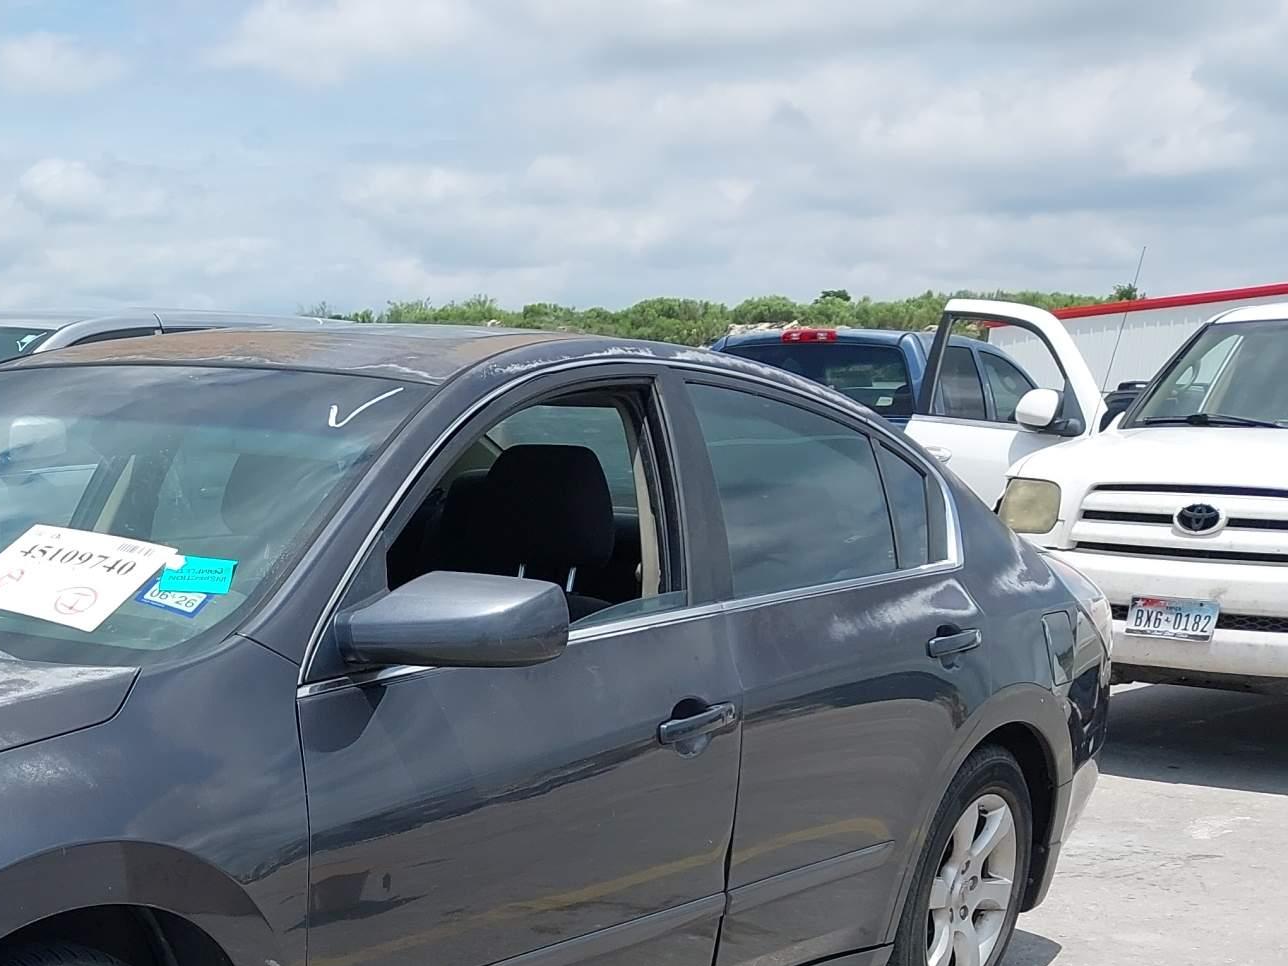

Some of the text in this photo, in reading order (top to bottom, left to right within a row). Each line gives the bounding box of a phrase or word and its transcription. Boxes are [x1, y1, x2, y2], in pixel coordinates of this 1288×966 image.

[20, 544, 137, 575] 45109740
[1134, 608, 1212, 633] BX6 0182
